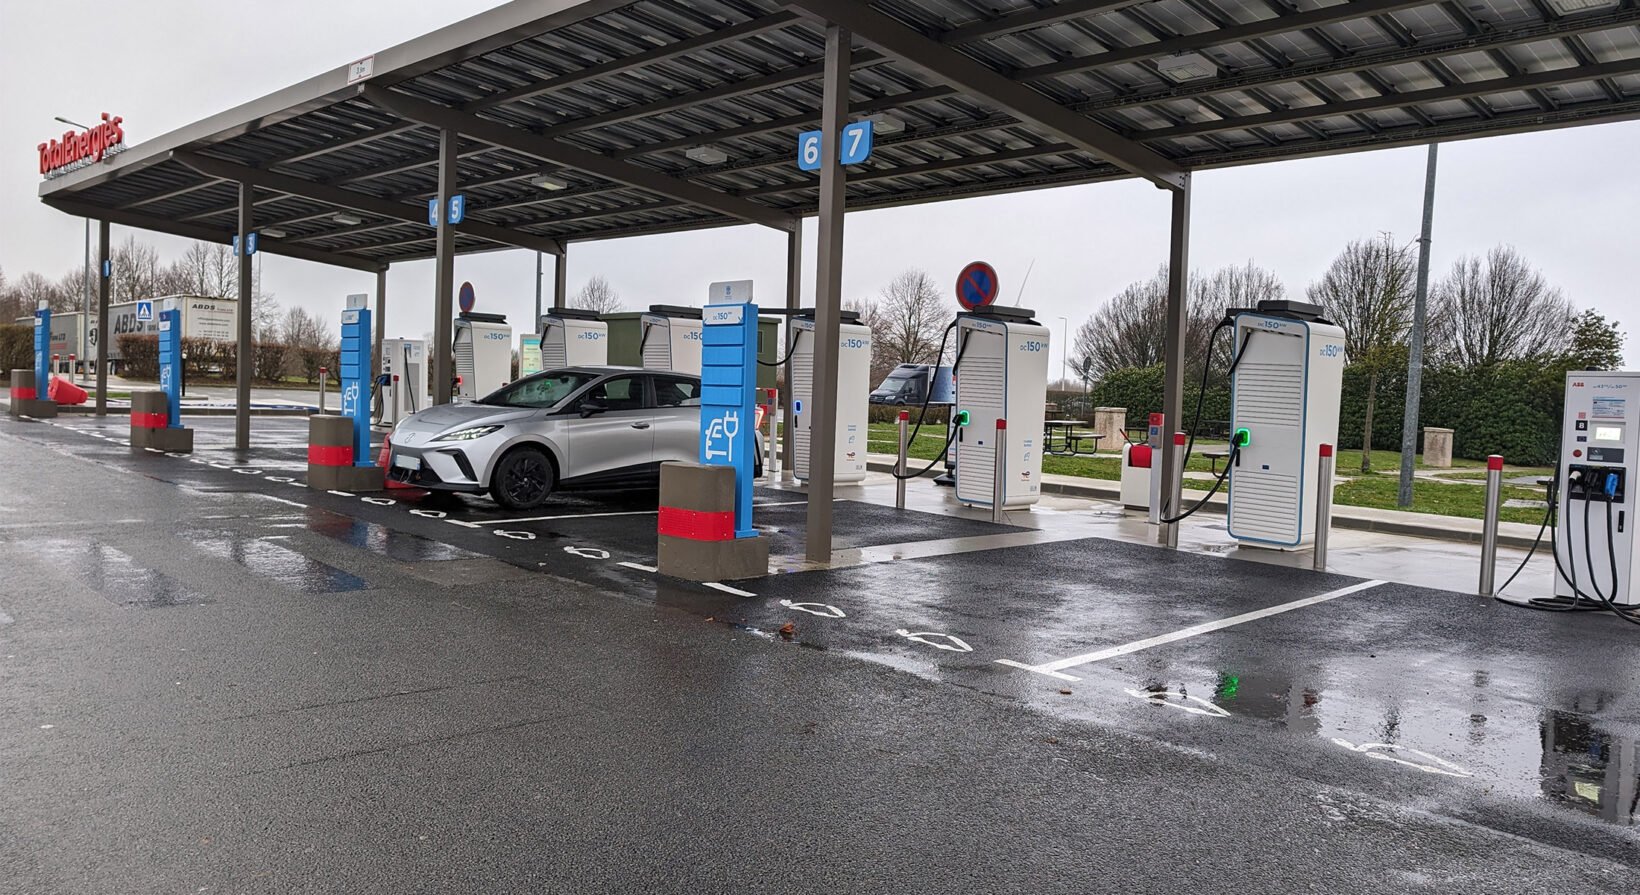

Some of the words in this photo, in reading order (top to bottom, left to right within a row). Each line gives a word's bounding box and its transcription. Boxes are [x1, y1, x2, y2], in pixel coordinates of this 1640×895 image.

[38, 112, 123, 175] TotalEnergies
[804, 137, 818, 164] 6
[848, 128, 863, 157] 7
[431, 203, 438, 222] 4
[451, 200, 459, 219] 5
[248, 236, 254, 252] 3
